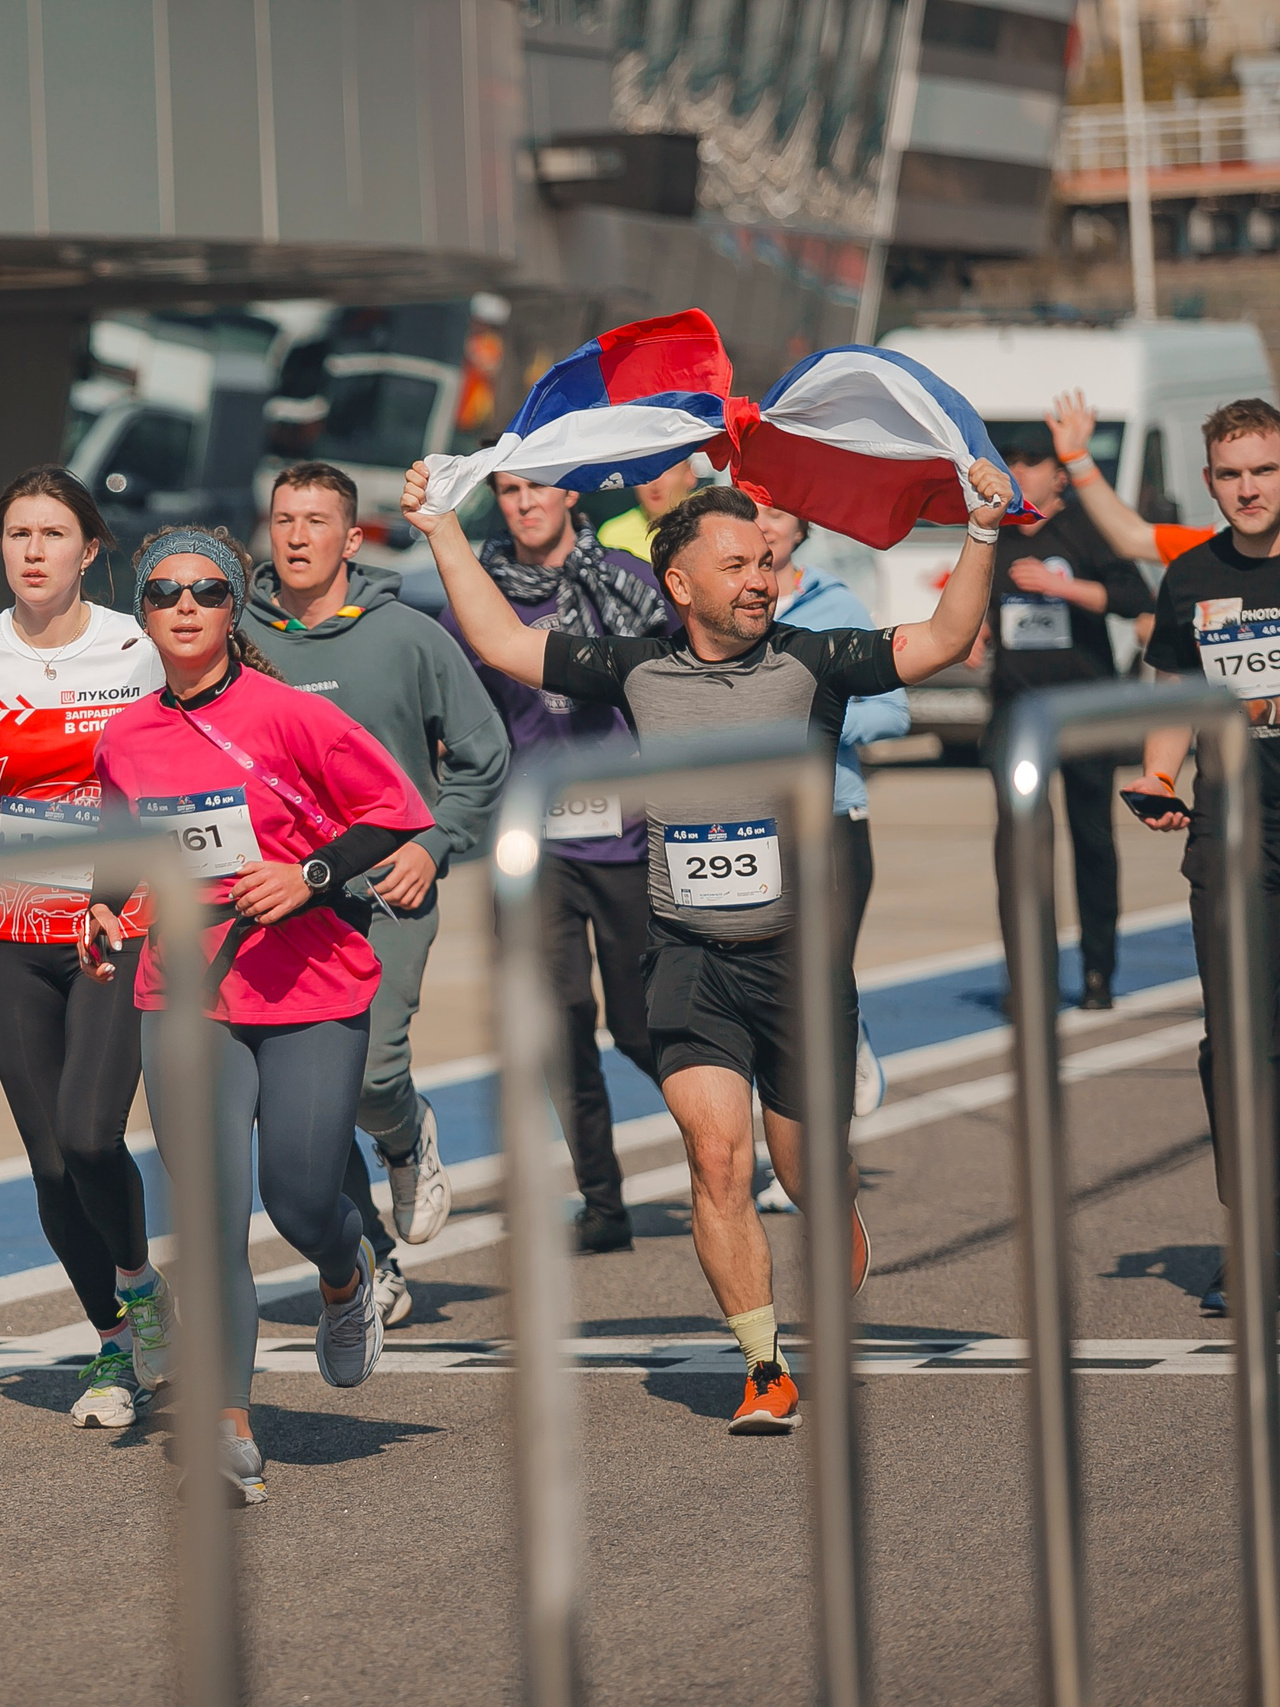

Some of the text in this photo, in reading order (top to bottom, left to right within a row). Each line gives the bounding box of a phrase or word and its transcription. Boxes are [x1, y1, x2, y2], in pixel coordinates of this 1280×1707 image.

[1214, 649, 1280, 676] 1769
[76, 685, 140, 702] ЛУКОЙЛ
[64, 722, 76, 734] В
[205, 795, 221, 806] 4,6
[9, 802, 24, 813] 4,6
[74, 810, 90, 822] 4,6
[673, 830, 687, 840] 4,6
[737, 826, 753, 837] 4,6
[686, 853, 758, 879] 293
